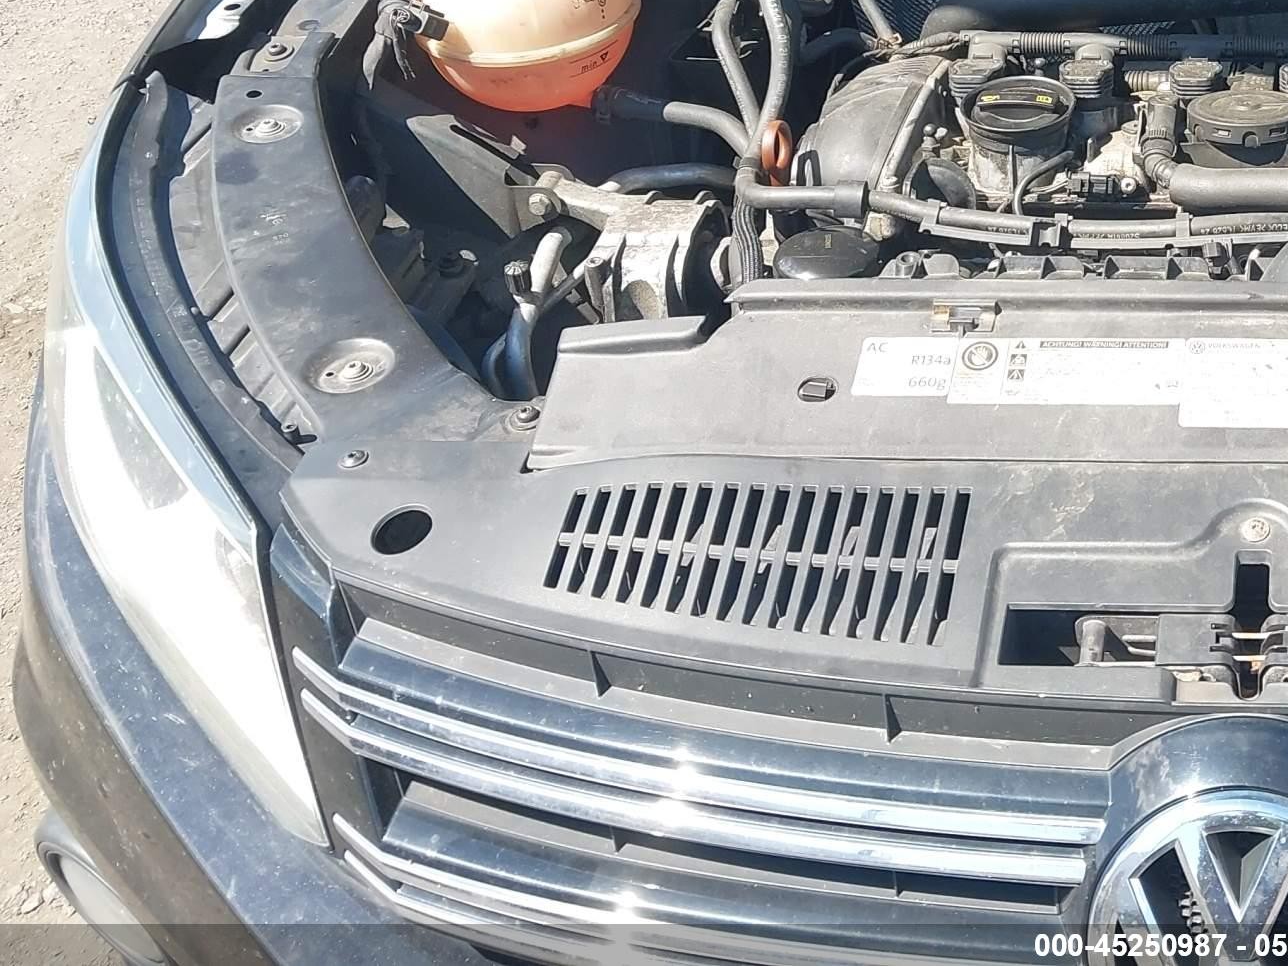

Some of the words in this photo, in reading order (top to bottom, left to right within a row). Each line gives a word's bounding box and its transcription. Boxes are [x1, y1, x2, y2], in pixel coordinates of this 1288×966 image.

[866, 342, 888, 353] AC
[911, 354, 951, 366] R134a
[908, 377, 947, 391] 660g
